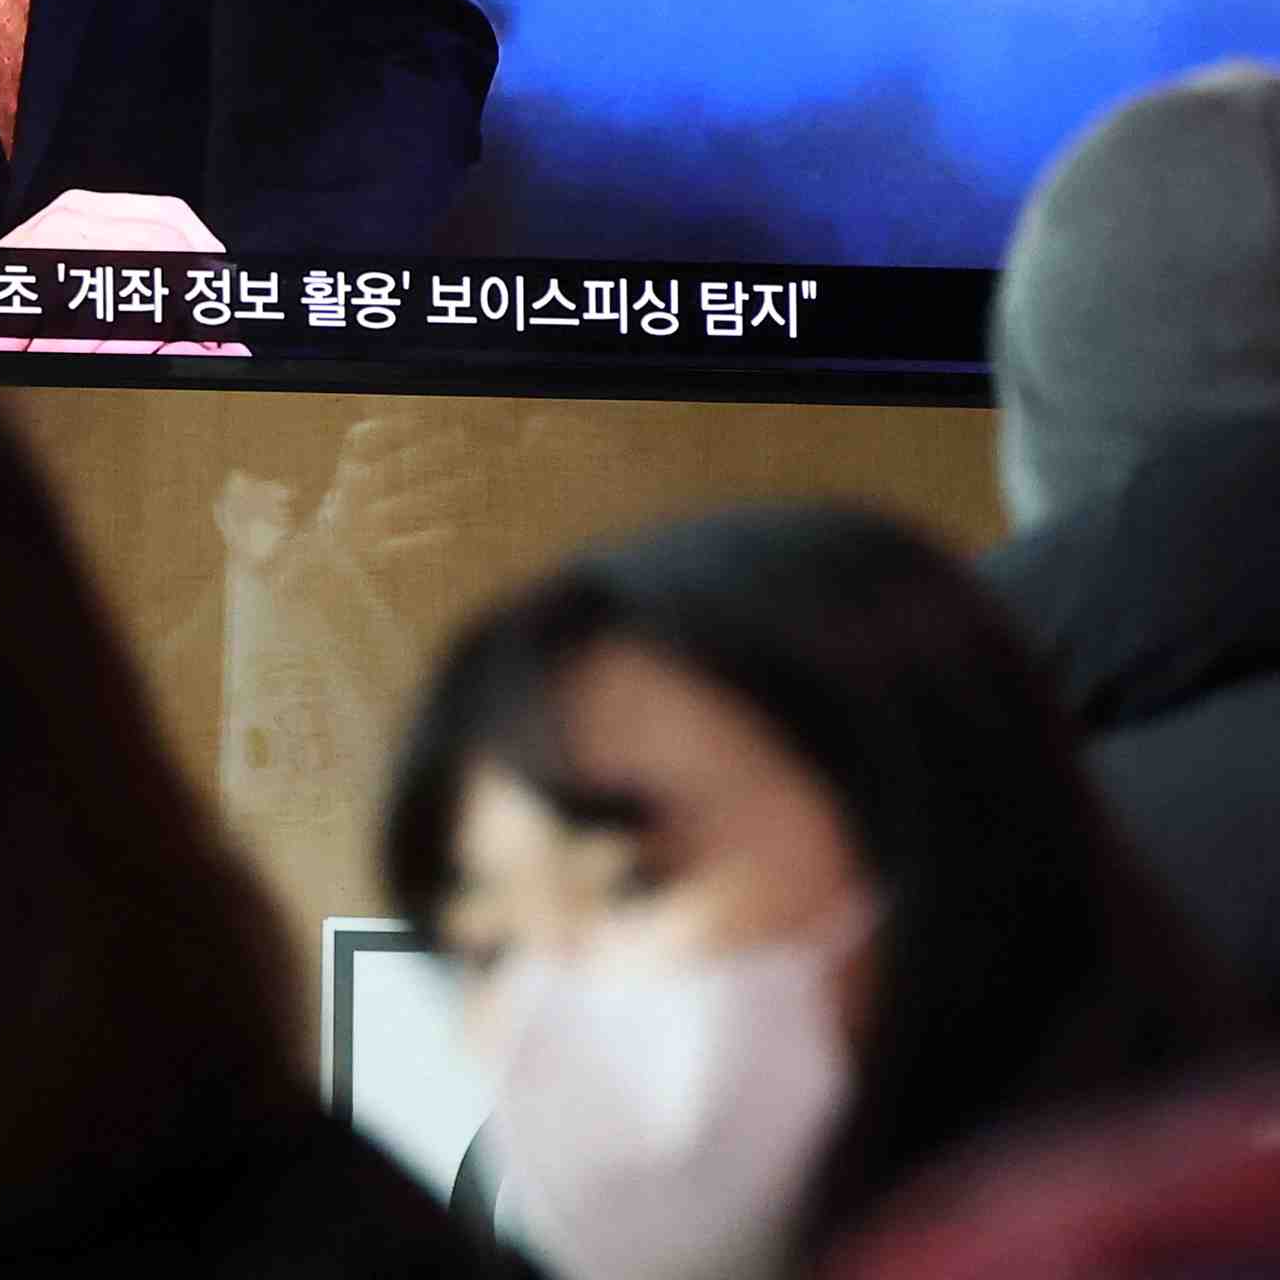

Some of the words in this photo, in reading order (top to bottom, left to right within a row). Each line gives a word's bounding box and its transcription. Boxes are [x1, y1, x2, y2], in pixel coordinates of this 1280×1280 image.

[56, 264, 170, 324] '계좌
[184, 267, 285, 326] 정보
[300, 270, 411, 330] 활용'
[426, 275, 679, 335] 보이스피싱
[700, 279, 817, 338] 탐지"
